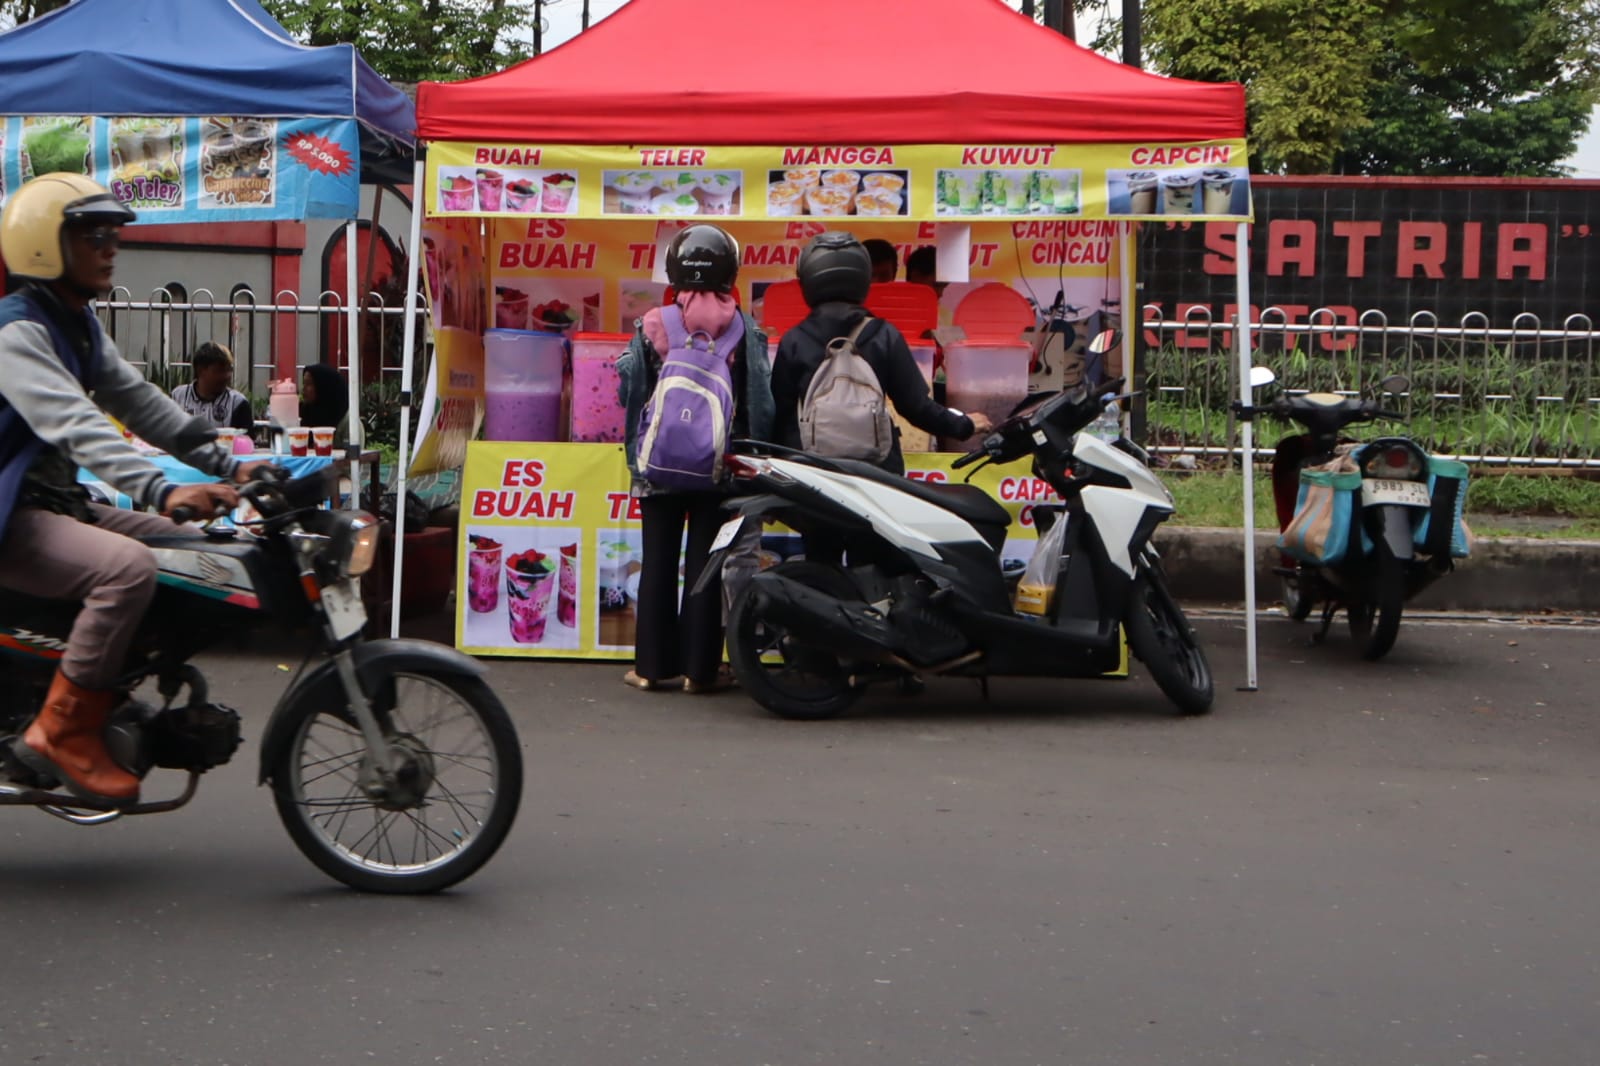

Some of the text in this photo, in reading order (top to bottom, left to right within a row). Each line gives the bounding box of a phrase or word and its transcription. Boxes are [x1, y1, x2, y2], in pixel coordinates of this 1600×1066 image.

[475, 148, 541, 165] BUAH
[640, 150, 705, 166] TELER
[783, 147, 893, 165] MANGGA
[962, 147, 1055, 165] KUWUT
[1131, 146, 1230, 165] CAPCIN
[135, 177, 177, 200] Teler
[527, 219, 566, 238] ES
[500, 244, 596, 269] BUAH
[1032, 242, 1110, 264] CINCAU
[503, 461, 543, 486] ES
[473, 493, 573, 518] BUAH
